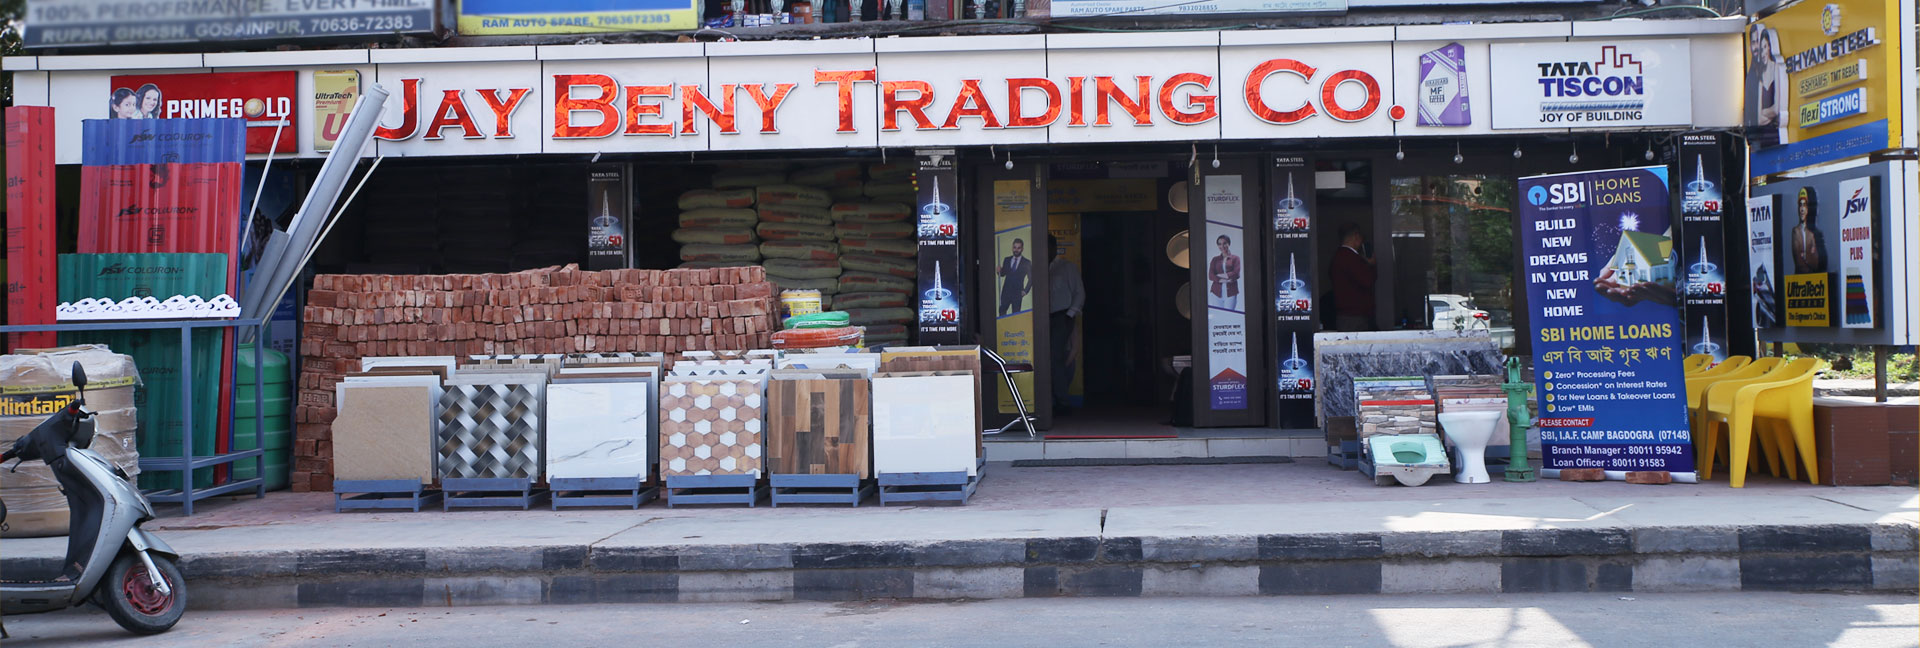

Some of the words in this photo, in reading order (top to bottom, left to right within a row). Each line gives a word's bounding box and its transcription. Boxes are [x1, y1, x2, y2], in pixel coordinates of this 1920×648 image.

[42, 27, 108, 43] RUPAK
[195, 20, 305, 38] GOSAINPUR,
[311, 15, 414, 33] 70636-72383
[482, 18, 509, 28] RAM
[513, 18, 547, 28] AUTO
[1785, 42, 1828, 74] SHYAM
[1831, 29, 1874, 58] STEEL
[1537, 61, 1592, 77] TATA
[1830, 69, 1841, 83] TMT
[1841, 63, 1859, 80] REBAR
[1430, 86, 1443, 95] MF
[1537, 76, 1644, 97] TISCON
[315, 92, 352, 100] UltraTech
[372, 78, 534, 142] JAY
[552, 72, 800, 141] BENY
[815, 65, 1219, 134] TRADING
[1800, 104, 1820, 125] flexi
[1820, 92, 1859, 119] STRONG
[1539, 113, 1564, 123] JOY
[1566, 112, 1582, 122] OF
[1586, 110, 1643, 121] BUILDING
[1549, 181, 1586, 205] SBI
[1594, 176, 1641, 191] HOME
[1596, 190, 1642, 206] LOANS
[1842, 189, 1869, 220] JSW
[1751, 205, 1771, 222] TATA
[1535, 218, 1576, 232] BUILD
[1842, 226, 1870, 242] COLOURON
[1541, 235, 1572, 248] NEW
[1529, 252, 1588, 266] DREAMS
[1849, 246, 1863, 261] PLUS
[1531, 272, 1546, 284] IN
[1550, 269, 1589, 282] YOUR
[1546, 288, 1577, 300] NEW
[1787, 279, 1825, 298] UltraTech
[1543, 305, 1583, 318] HOME
[1540, 327, 1565, 342] SBI
[1570, 325, 1615, 341] HOME
[1619, 323, 1673, 340] LOANS
[1542, 350, 1564, 364] এস
[1567, 346, 1582, 363] বি
[1585, 345, 1614, 363] আই
[1619, 347, 1641, 367] গৃহ
[1577, 370, 1616, 380] Processing
[1617, 370, 1636, 378] Fees
[1616, 381, 1644, 389] Interest
[1645, 380, 1667, 388] Rates
[1557, 393, 1567, 401] for
[1569, 393, 1584, 401] New
[1586, 393, 1608, 401] Loans
[1617, 392, 1651, 401] Takeover
[1652, 392, 1675, 400] Loans
[1577, 404, 1595, 412] EMIs
[1540, 419, 1562, 427] PLEASE
[1562, 418, 1589, 426] CONTACT
[1541, 432, 1558, 442] SBI,
[1559, 431, 1580, 441] I.A.F.
[1580, 431, 1605, 441] CAMP
[1606, 430, 1655, 440] BAGDOGRA
[1658, 430, 1691, 442] (07148)
[1551, 446, 1582, 456] Branch
[1584, 446, 1621, 457] Manager
[1628, 446, 1653, 455] 80011
[1655, 446, 1682, 455] 95942
[1553, 458, 1574, 468] Loan
[1576, 458, 1606, 467] Officer
[1612, 458, 1637, 467] 80011
[1639, 458, 1666, 467] 91583
